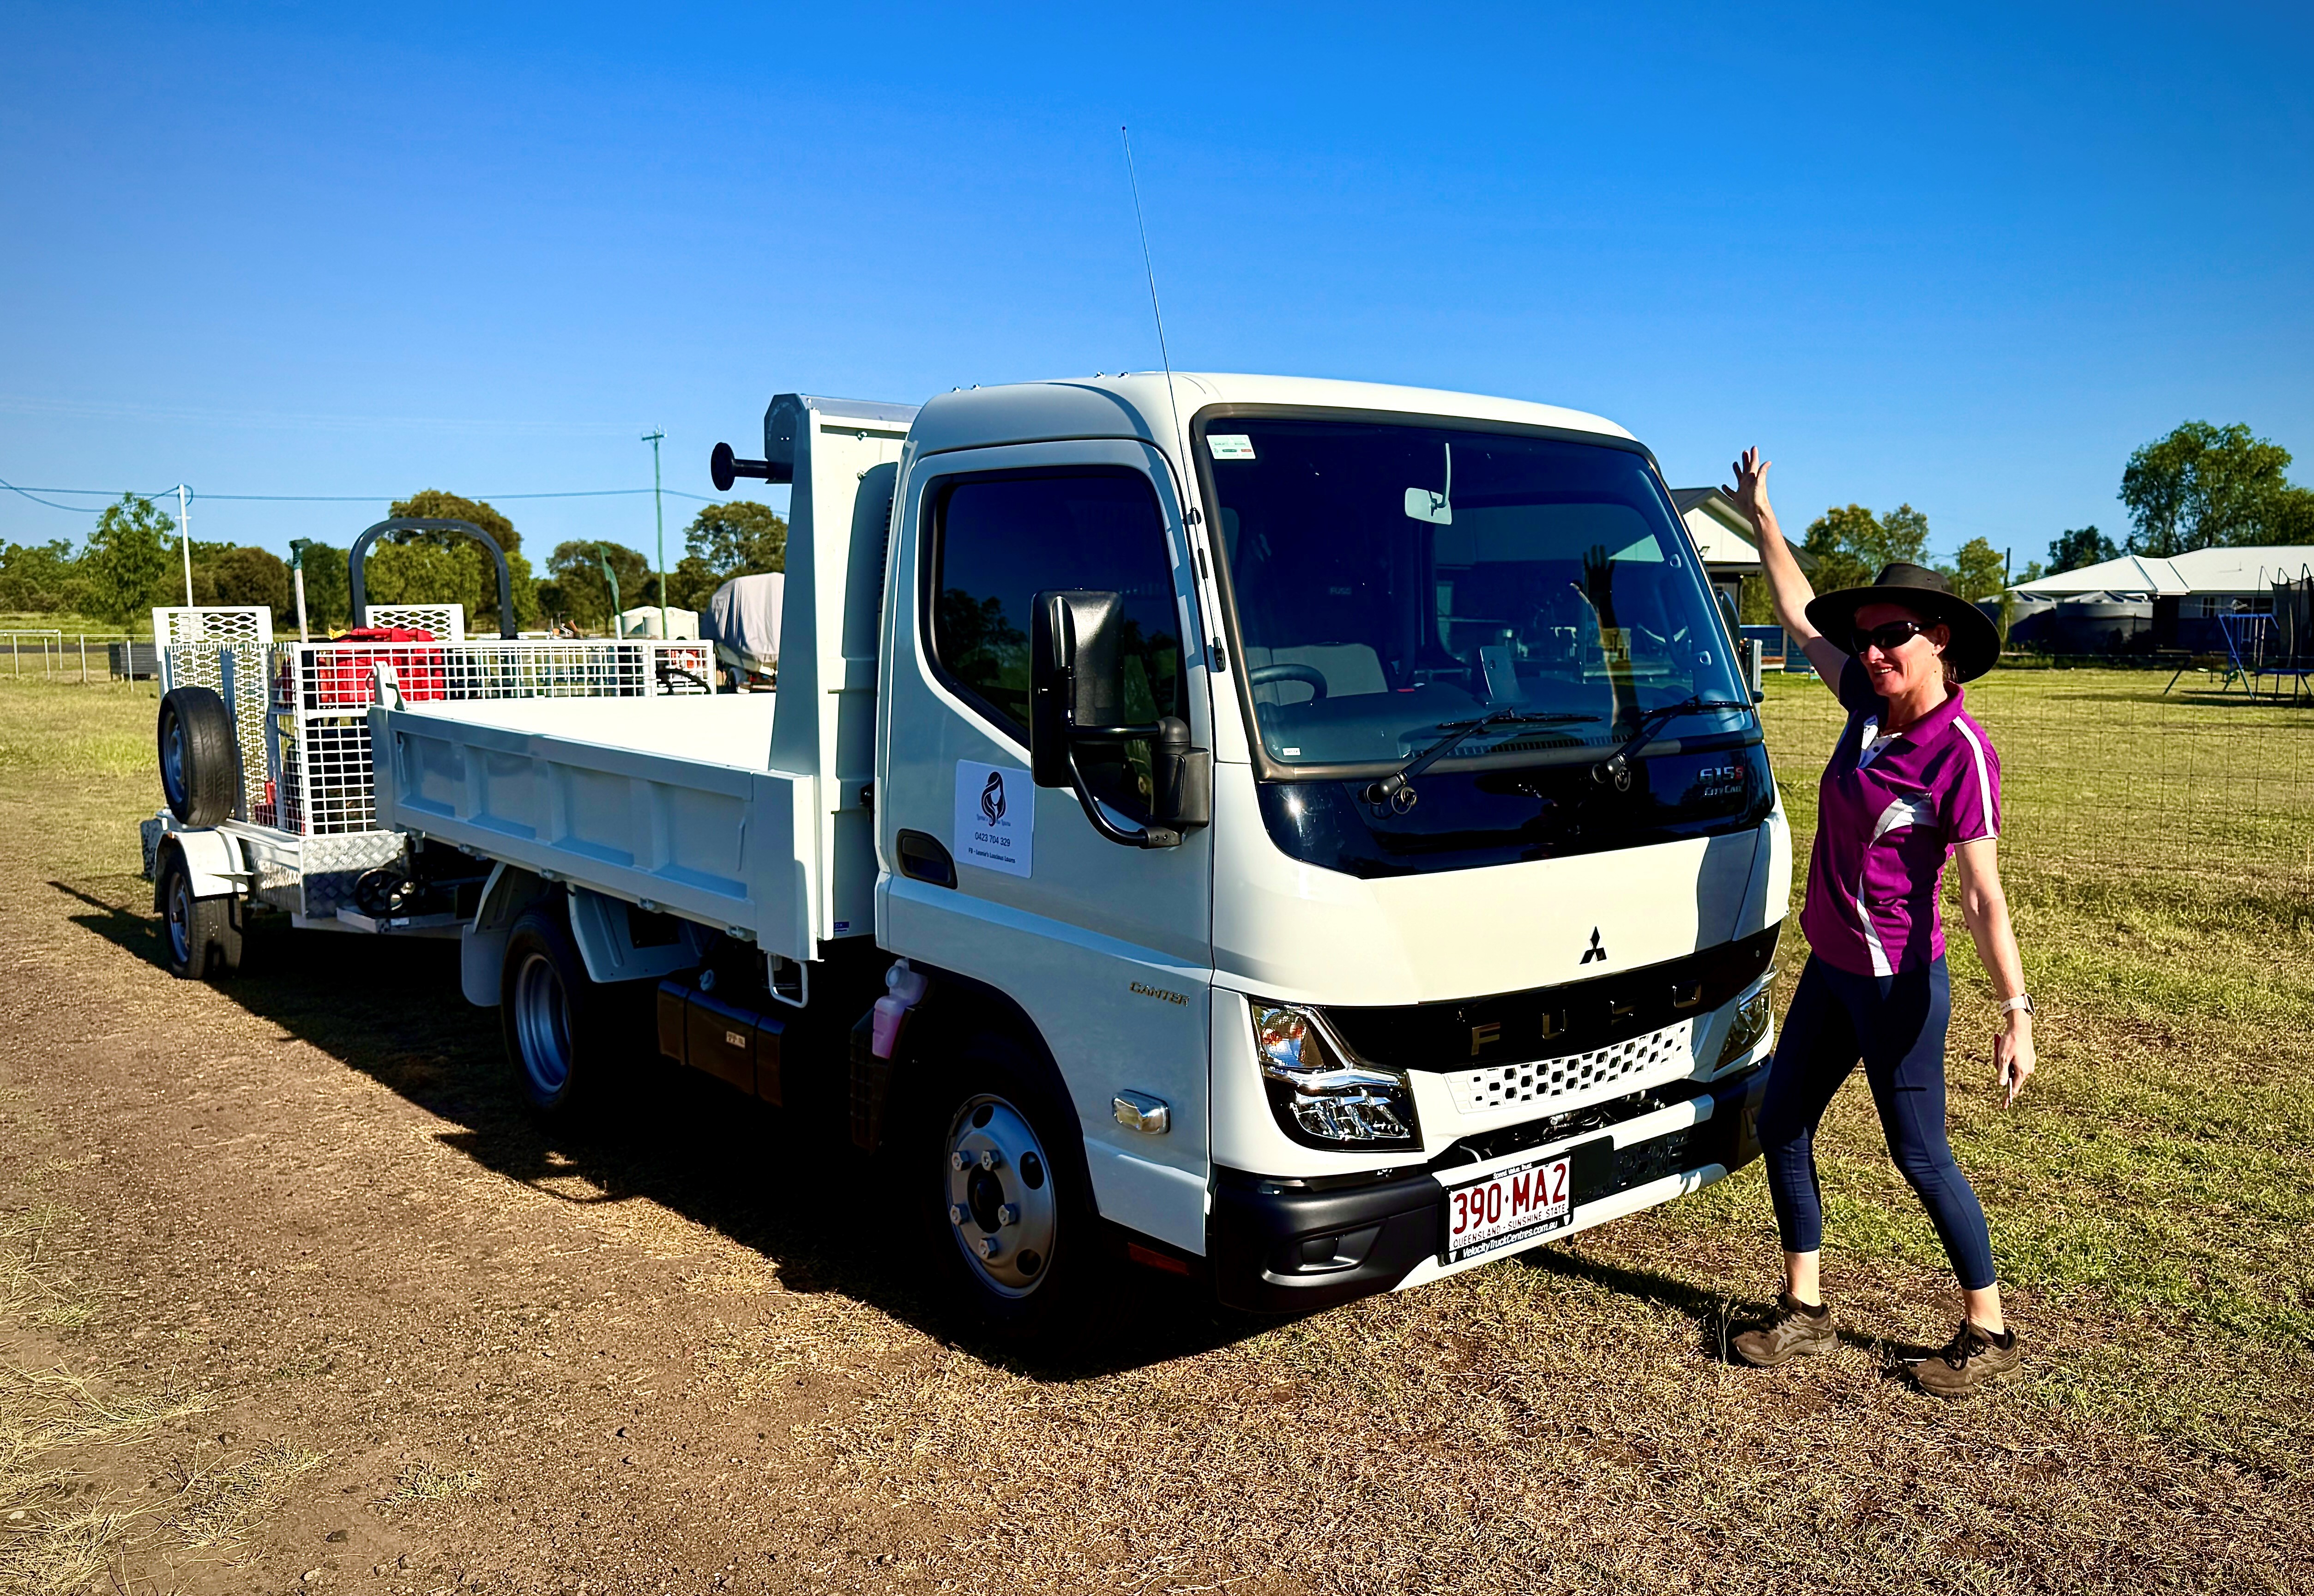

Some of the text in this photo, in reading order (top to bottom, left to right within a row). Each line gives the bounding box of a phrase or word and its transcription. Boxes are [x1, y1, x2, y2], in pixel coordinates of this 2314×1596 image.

[975, 832, 1010, 846] 0423 704 329
[1130, 981, 1190, 1006] CANTER
[1471, 980, 1702, 1056] FUSO
[1453, 1225, 1500, 1247] QUEENSLAND
[1508, 1213, 1542, 1230] SUNSHINE
[1546, 1204, 1565, 1218] STATE
[1463, 1221, 1558, 1258] VelocityTruckCentres.com.au
